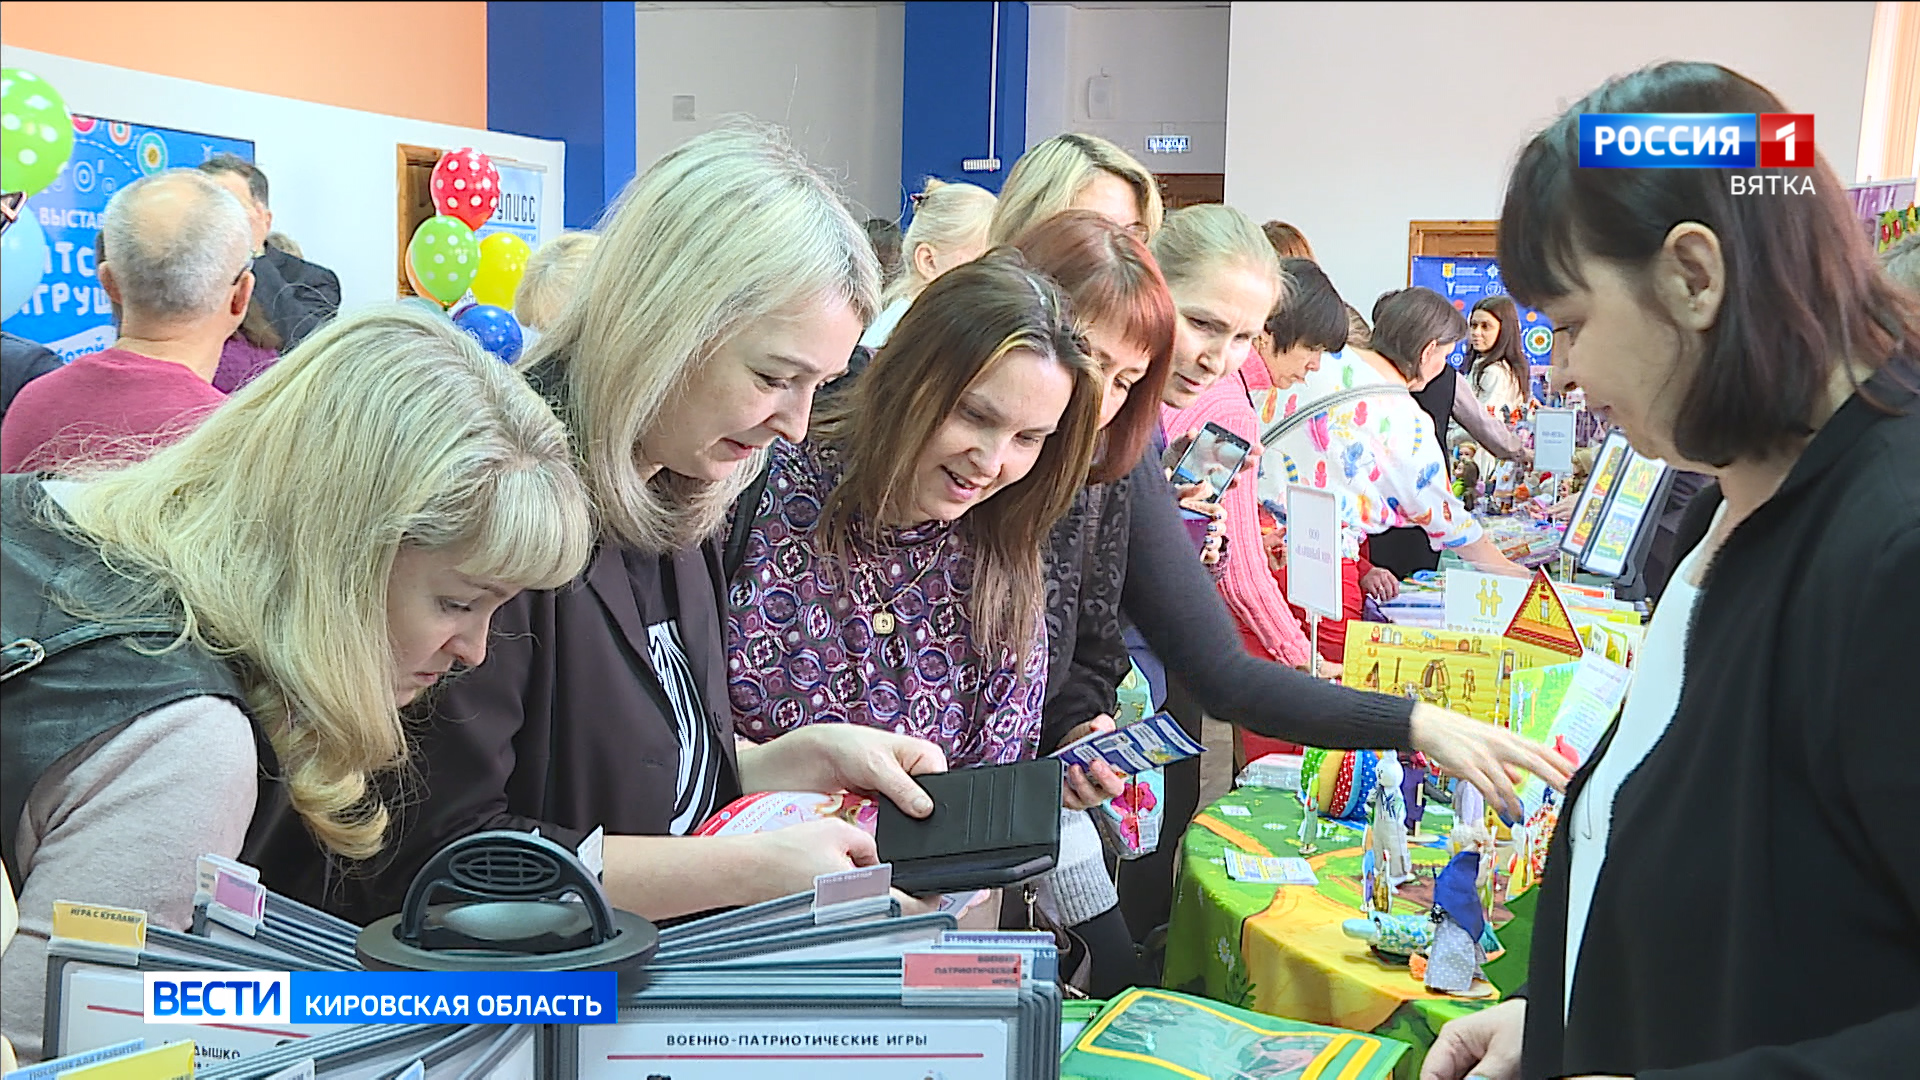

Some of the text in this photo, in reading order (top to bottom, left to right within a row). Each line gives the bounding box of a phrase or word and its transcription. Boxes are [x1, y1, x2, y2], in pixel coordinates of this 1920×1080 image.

[20, 282, 114, 316] ГРУШ
[666, 1033, 928, 1047] ВОЕННО-ПАТРИОТИЧЕСКИЕ ИГРЫ
